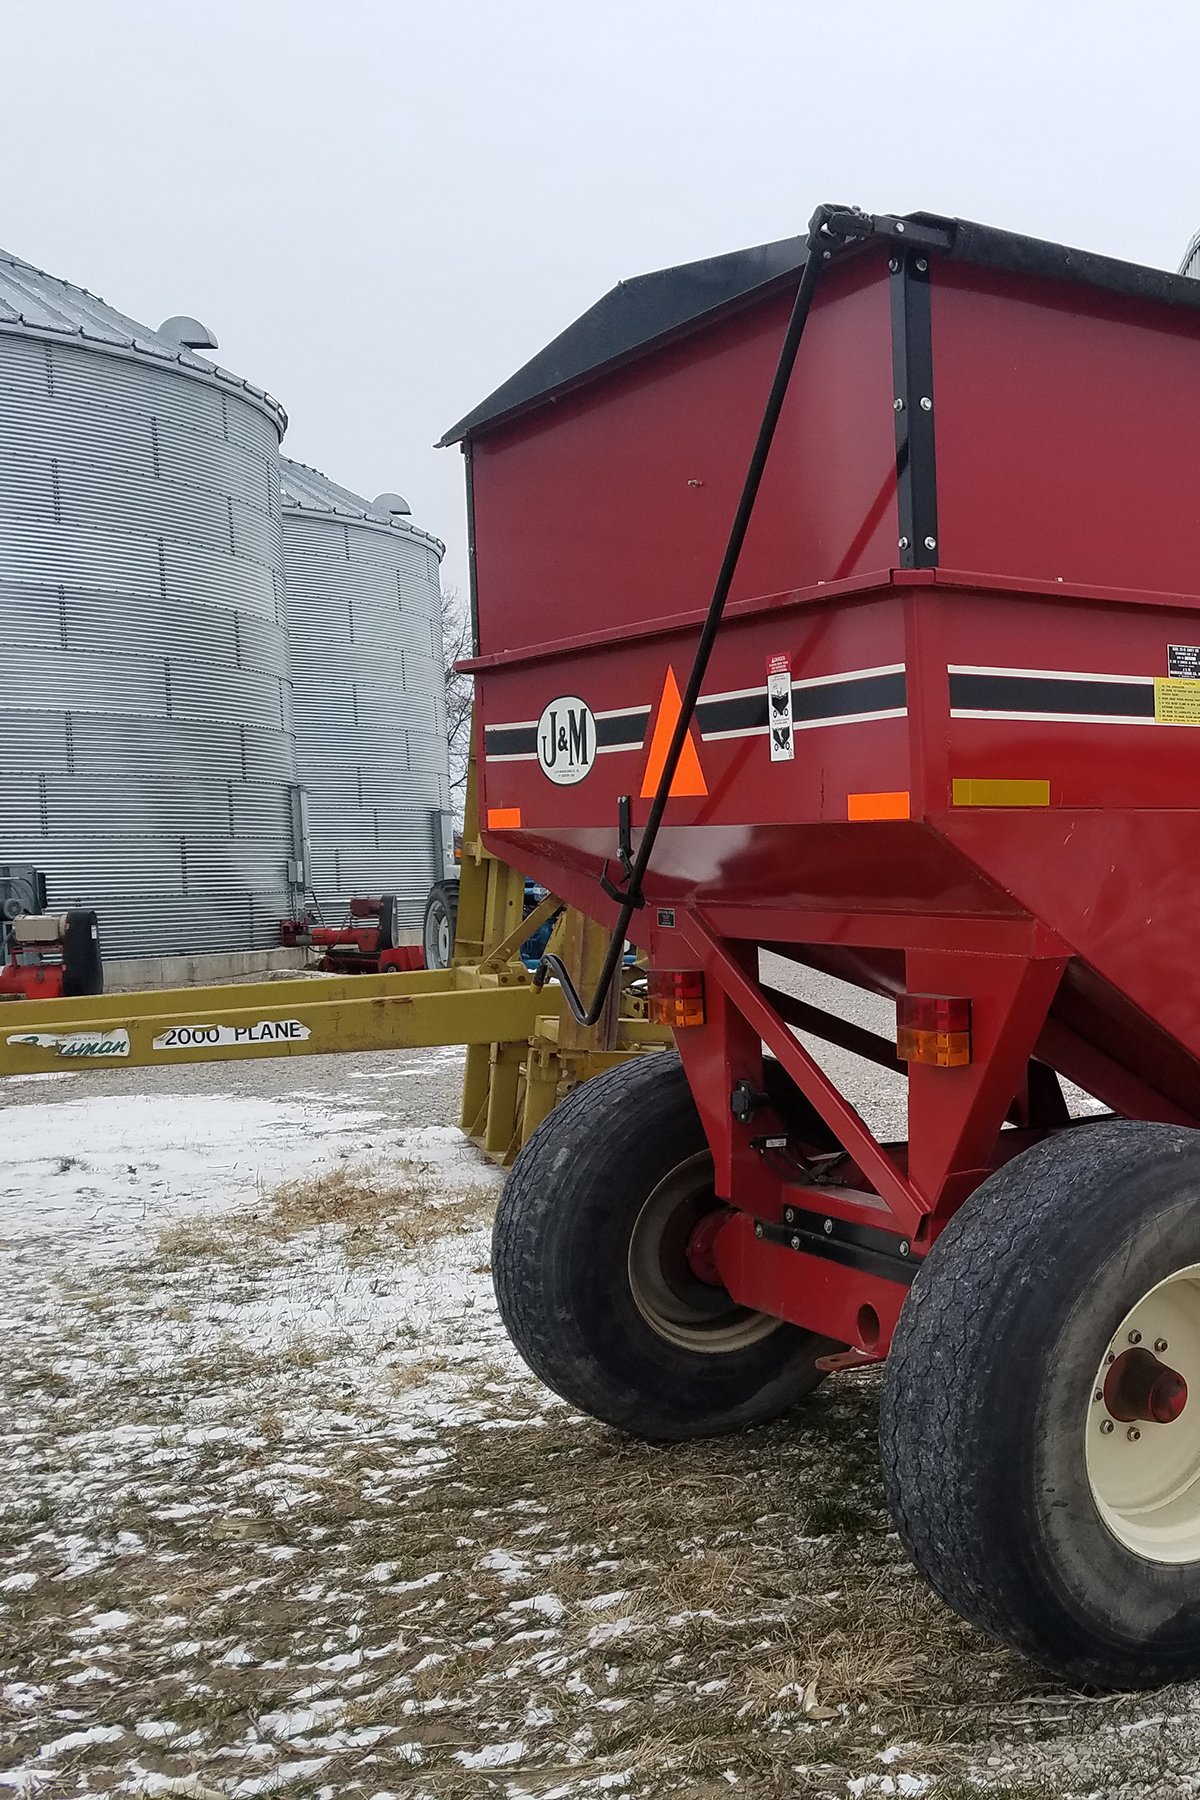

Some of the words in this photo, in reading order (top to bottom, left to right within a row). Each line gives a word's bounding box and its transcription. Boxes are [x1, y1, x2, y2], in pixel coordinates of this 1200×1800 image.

[541, 708, 589, 767] J&M
[165, 1028, 220, 1046] 2000
[234, 1022, 303, 1041] PLANE
